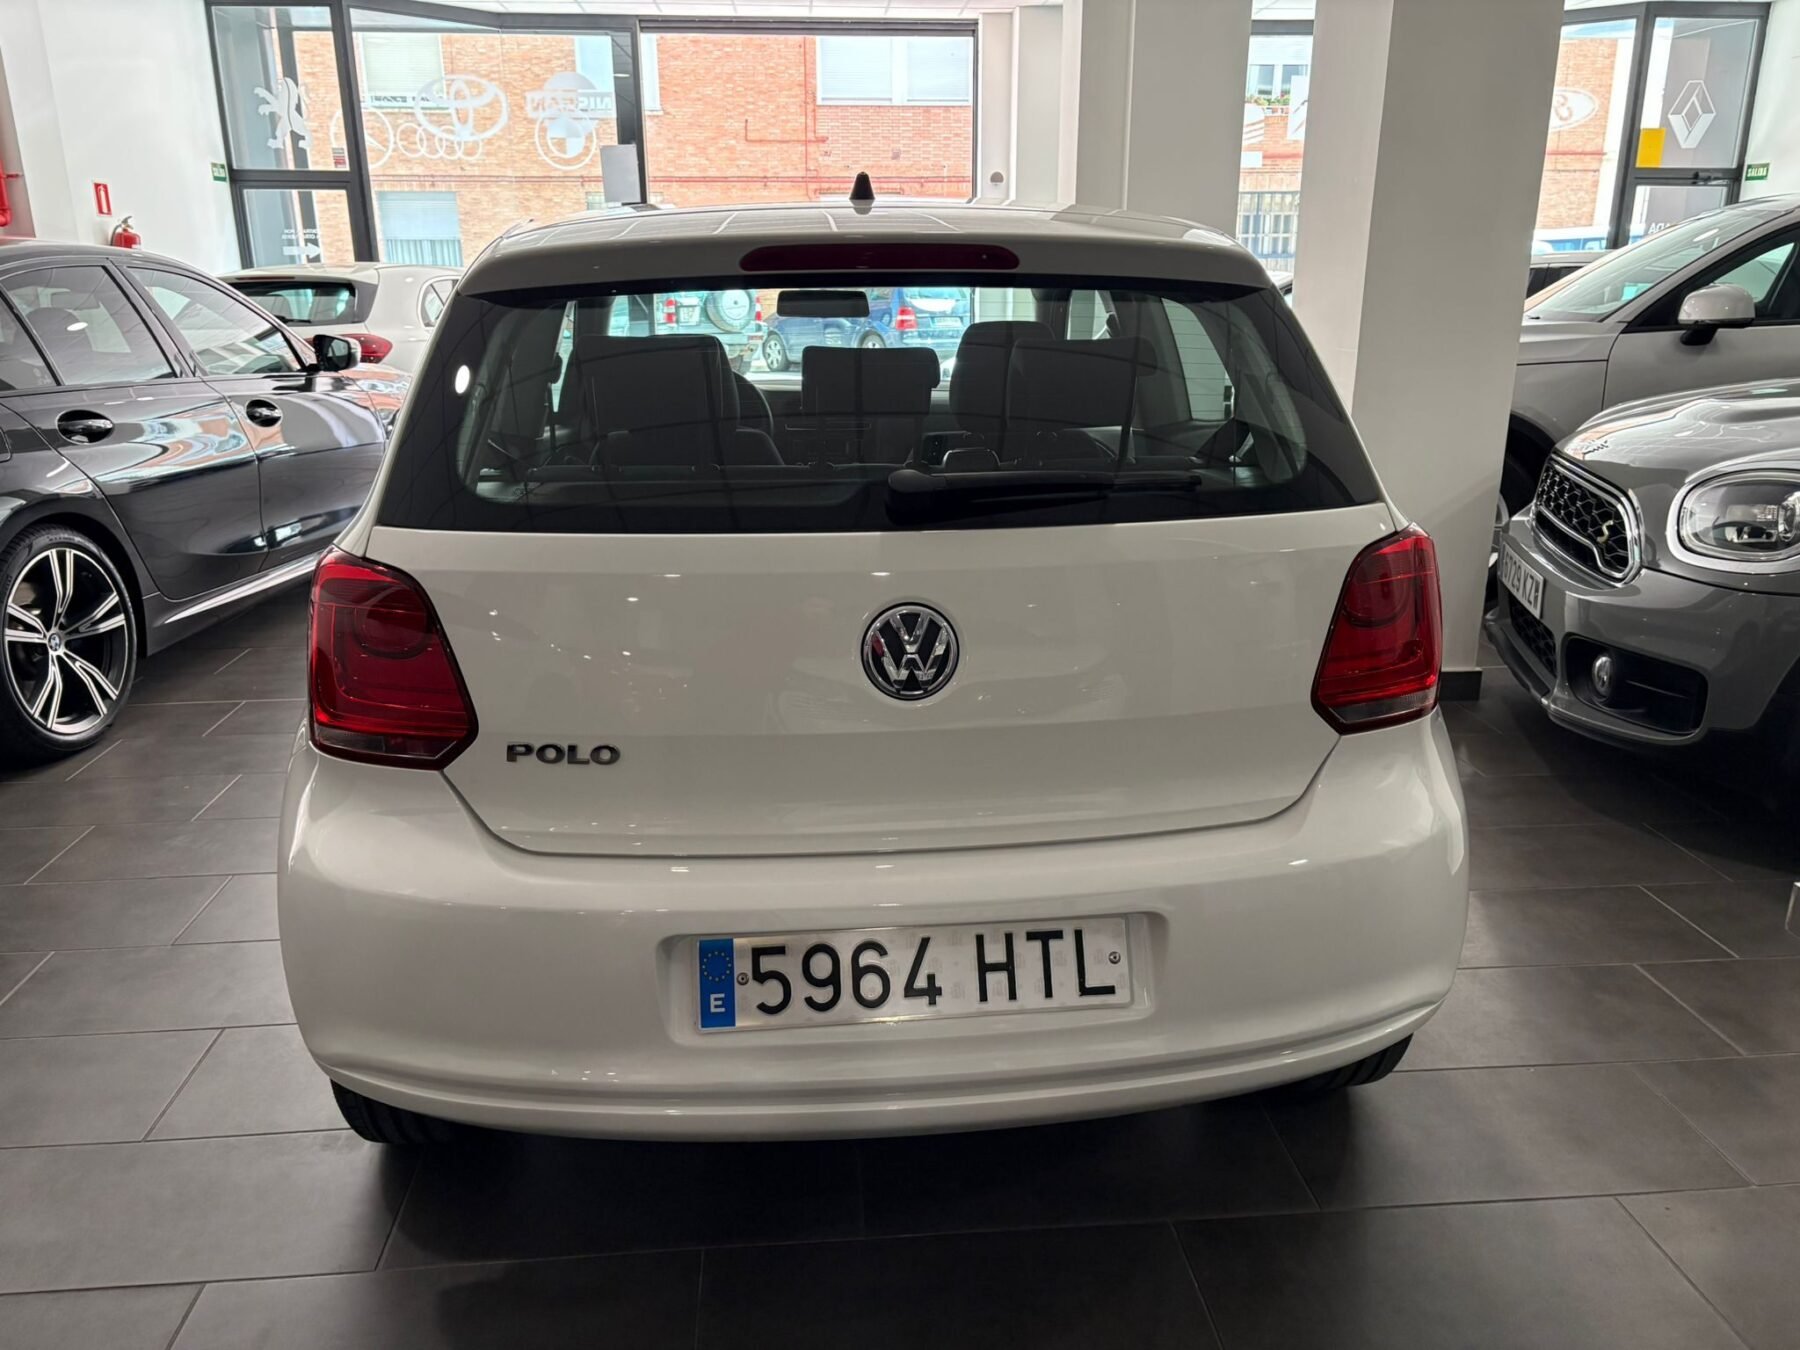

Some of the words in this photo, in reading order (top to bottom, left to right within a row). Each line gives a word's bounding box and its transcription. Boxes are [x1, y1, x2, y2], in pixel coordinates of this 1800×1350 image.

[506, 743, 621, 766] POLO
[710, 993, 725, 1013] E
[751, 937, 942, 1015] 5964
[975, 929, 1116, 1002] HTL
